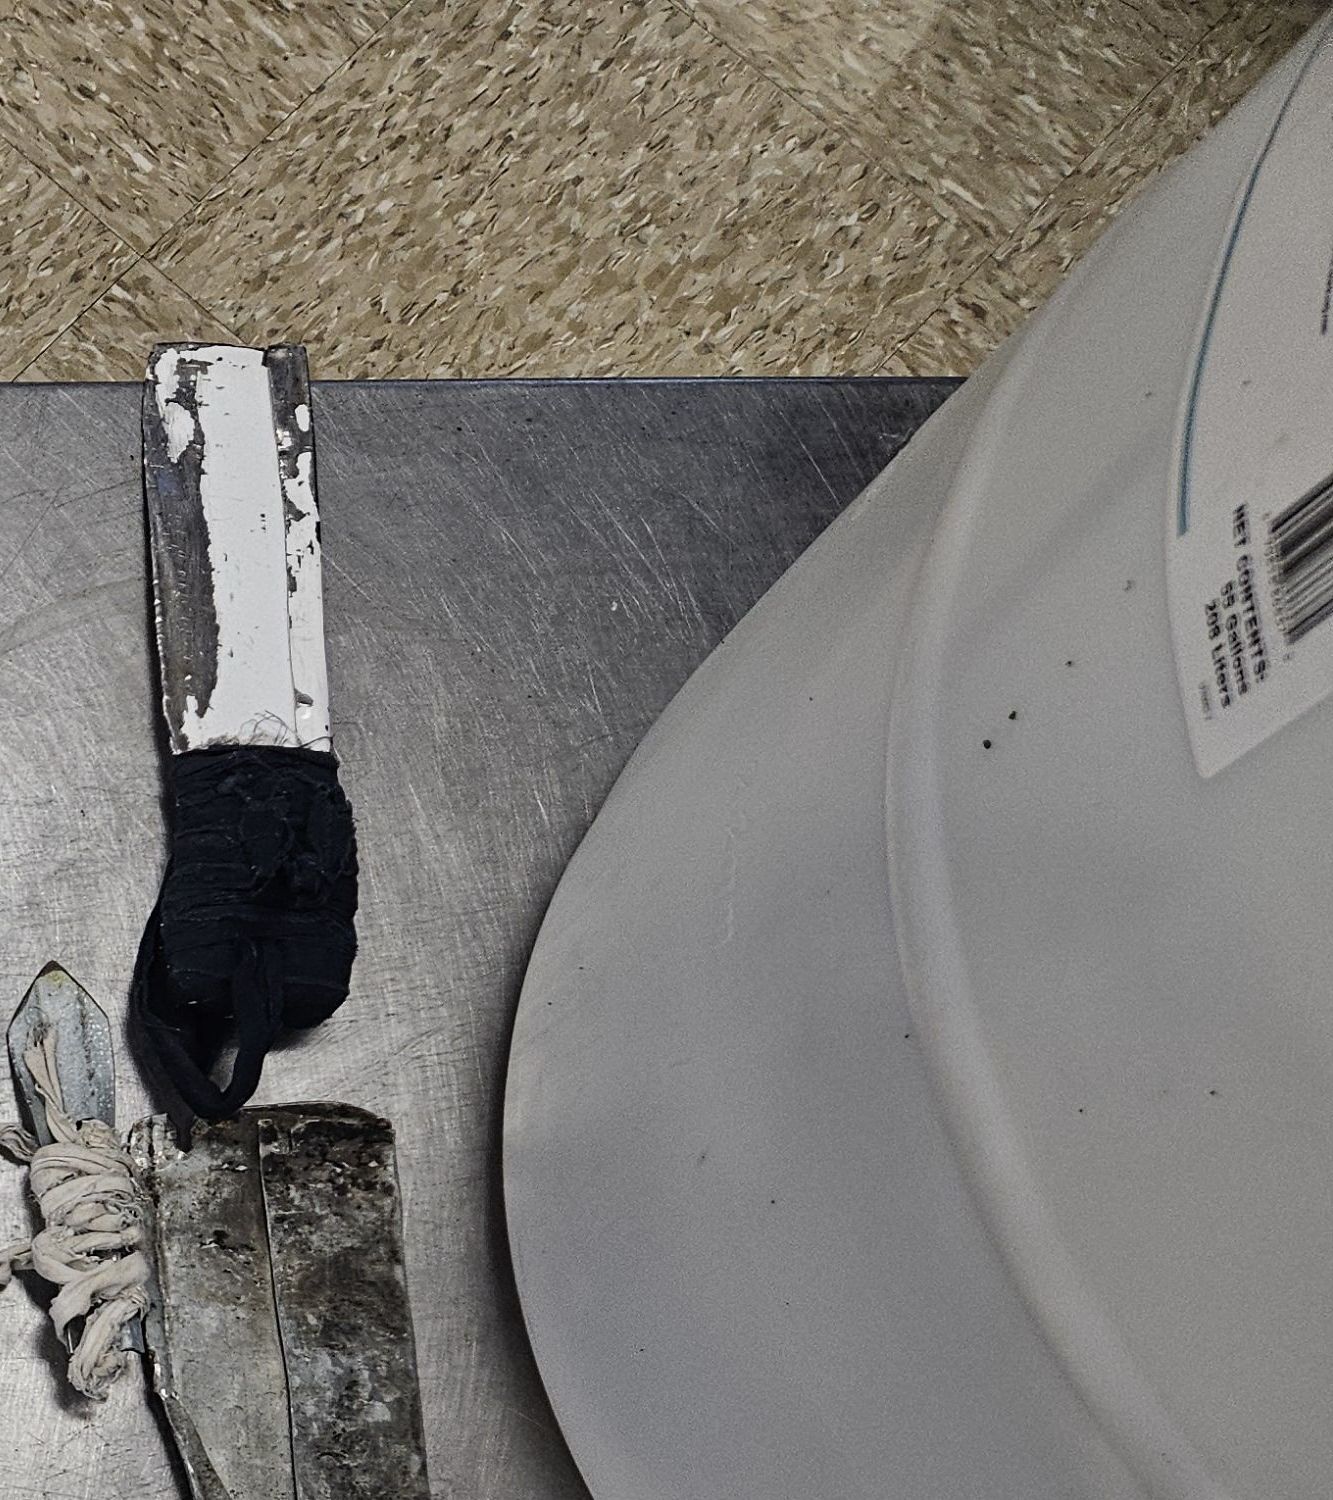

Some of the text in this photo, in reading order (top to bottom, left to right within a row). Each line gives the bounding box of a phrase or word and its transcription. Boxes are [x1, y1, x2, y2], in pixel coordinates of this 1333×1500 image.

[1234, 503, 1268, 683] NET CONTENTS:
[1211, 642, 1231, 708] Liters
[1225, 613, 1249, 695] Gallons
